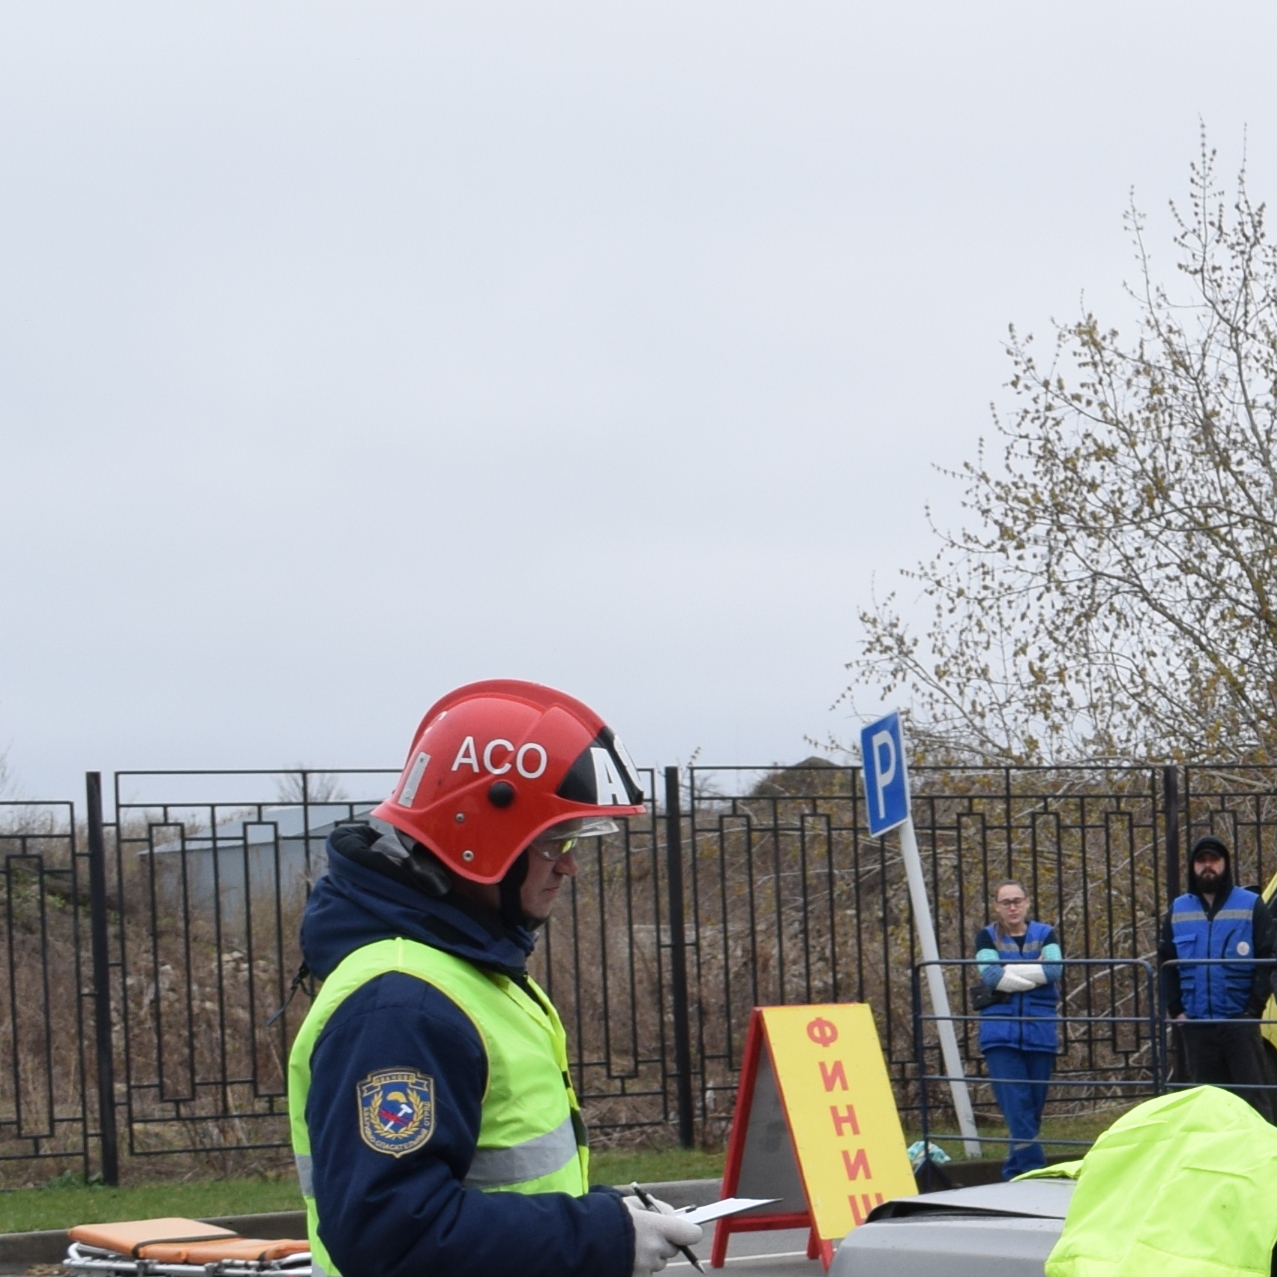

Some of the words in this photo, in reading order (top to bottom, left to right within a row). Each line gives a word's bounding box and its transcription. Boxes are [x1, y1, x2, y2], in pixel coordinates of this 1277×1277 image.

[451, 736, 548, 779] АСО
[872, 730, 896, 819] P
[806, 1016, 885, 1227] ФИНИШ
